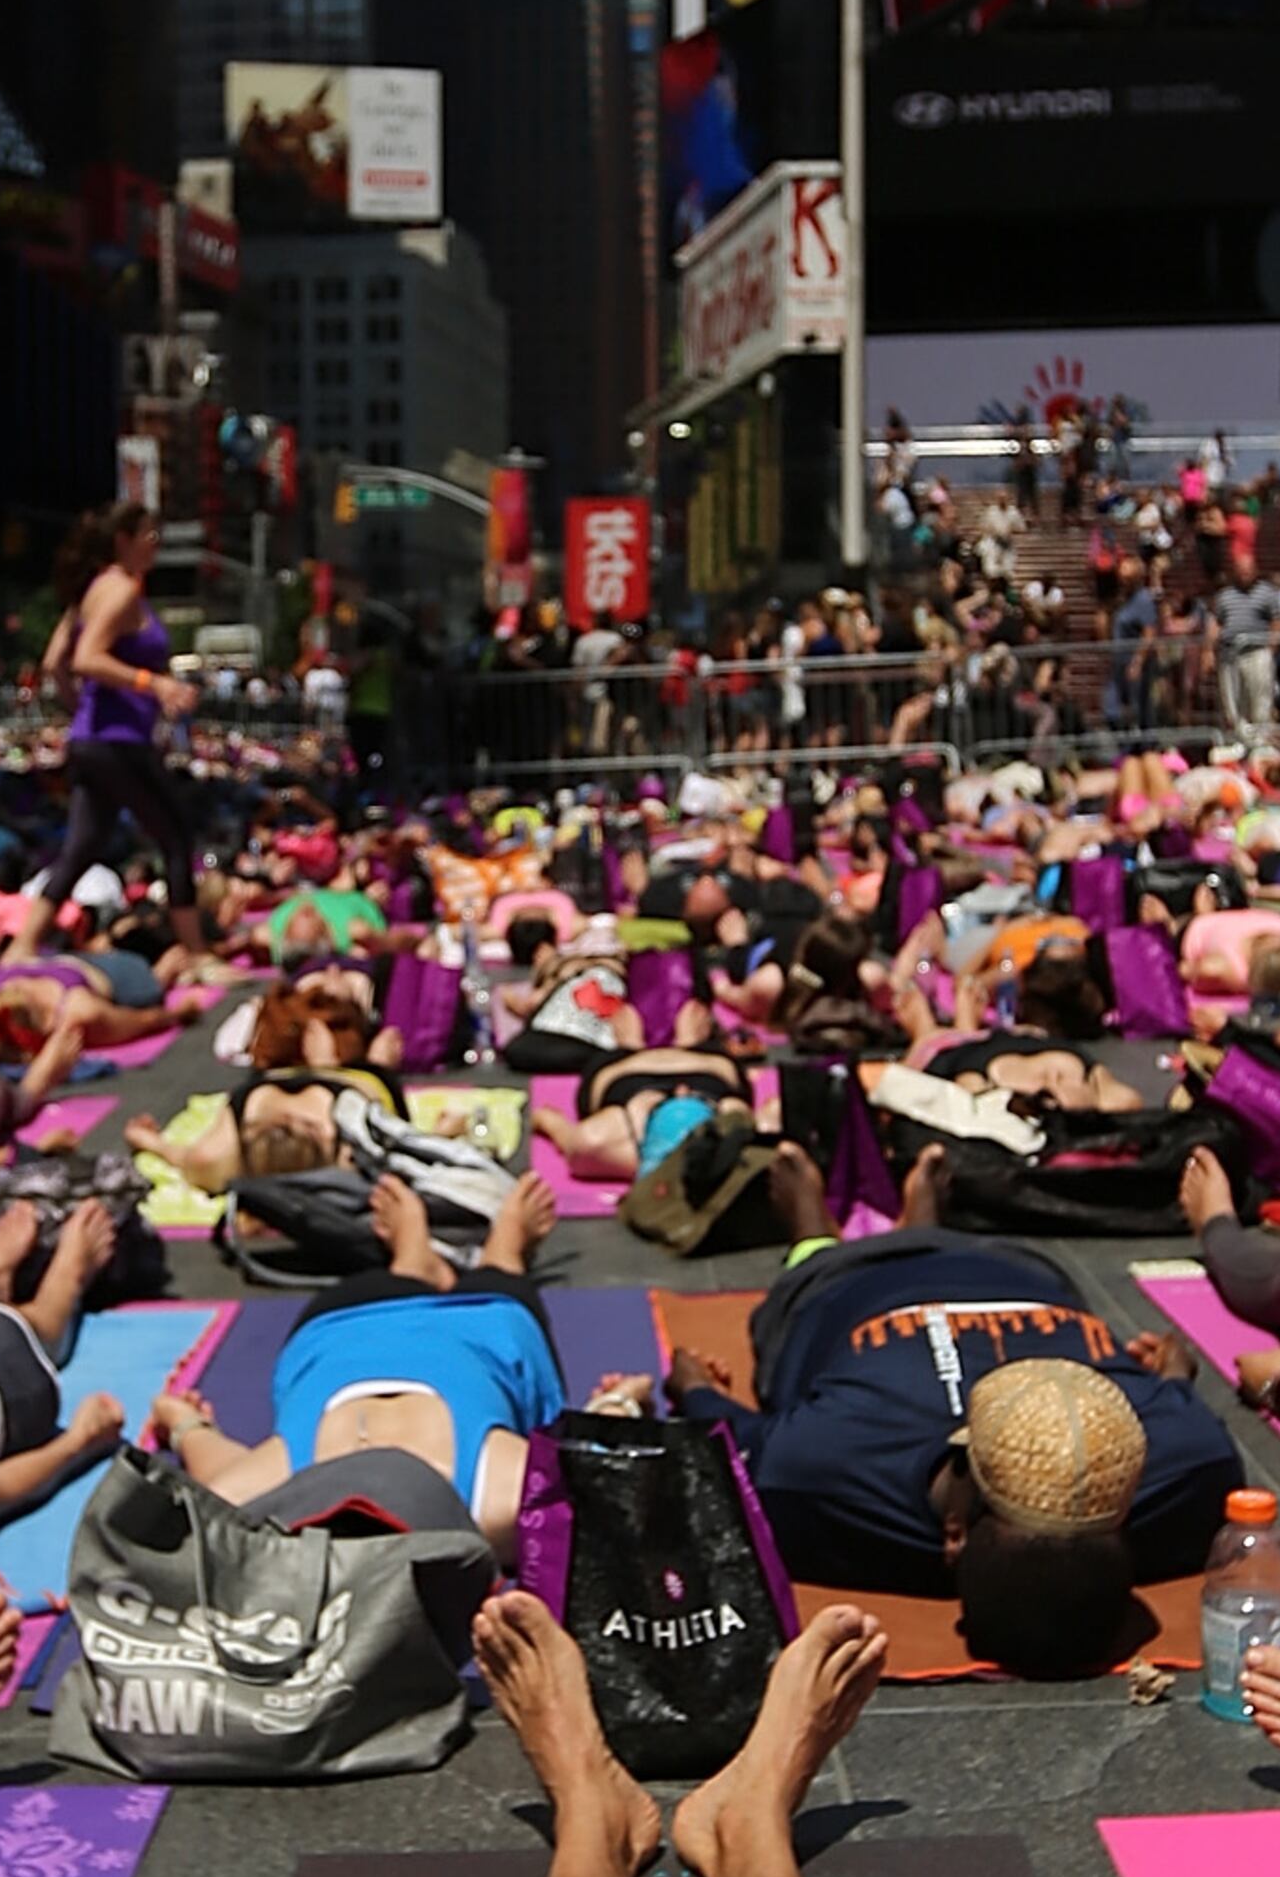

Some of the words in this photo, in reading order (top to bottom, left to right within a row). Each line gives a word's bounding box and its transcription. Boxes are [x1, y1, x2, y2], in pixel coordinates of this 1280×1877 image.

[959, 84, 1113, 121] HYUNDAI
[583, 509, 637, 613] tkts
[601, 1602, 747, 1650] ATHLETA
